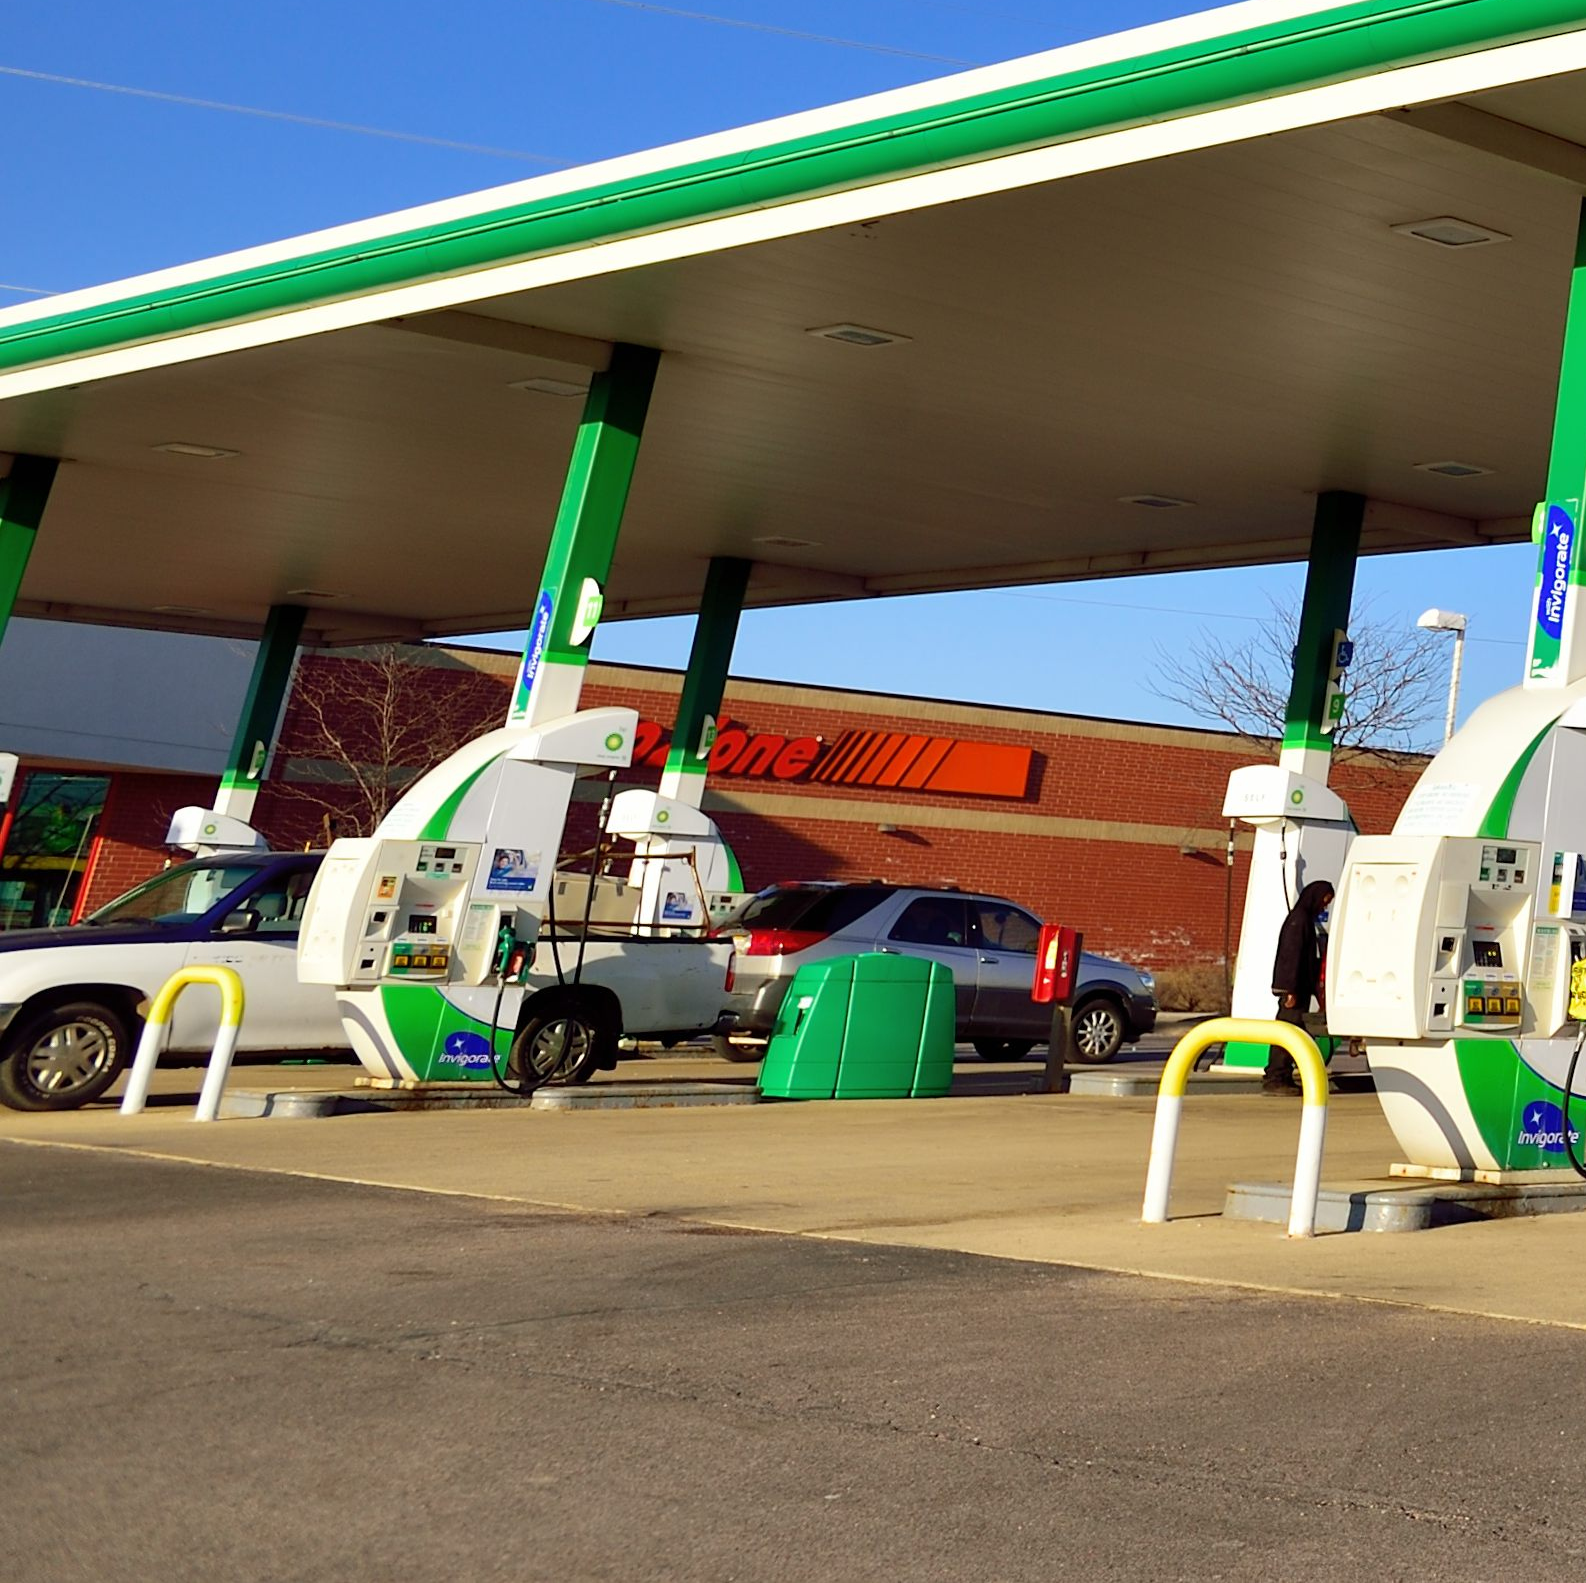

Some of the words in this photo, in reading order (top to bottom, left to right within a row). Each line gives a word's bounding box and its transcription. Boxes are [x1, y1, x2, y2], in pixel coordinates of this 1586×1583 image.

[1547, 532, 1570, 623] Invigorate
[586, 601, 598, 620] 11
[1332, 698, 1341, 713] 9
[439, 1052, 501, 1067] Invigorae
